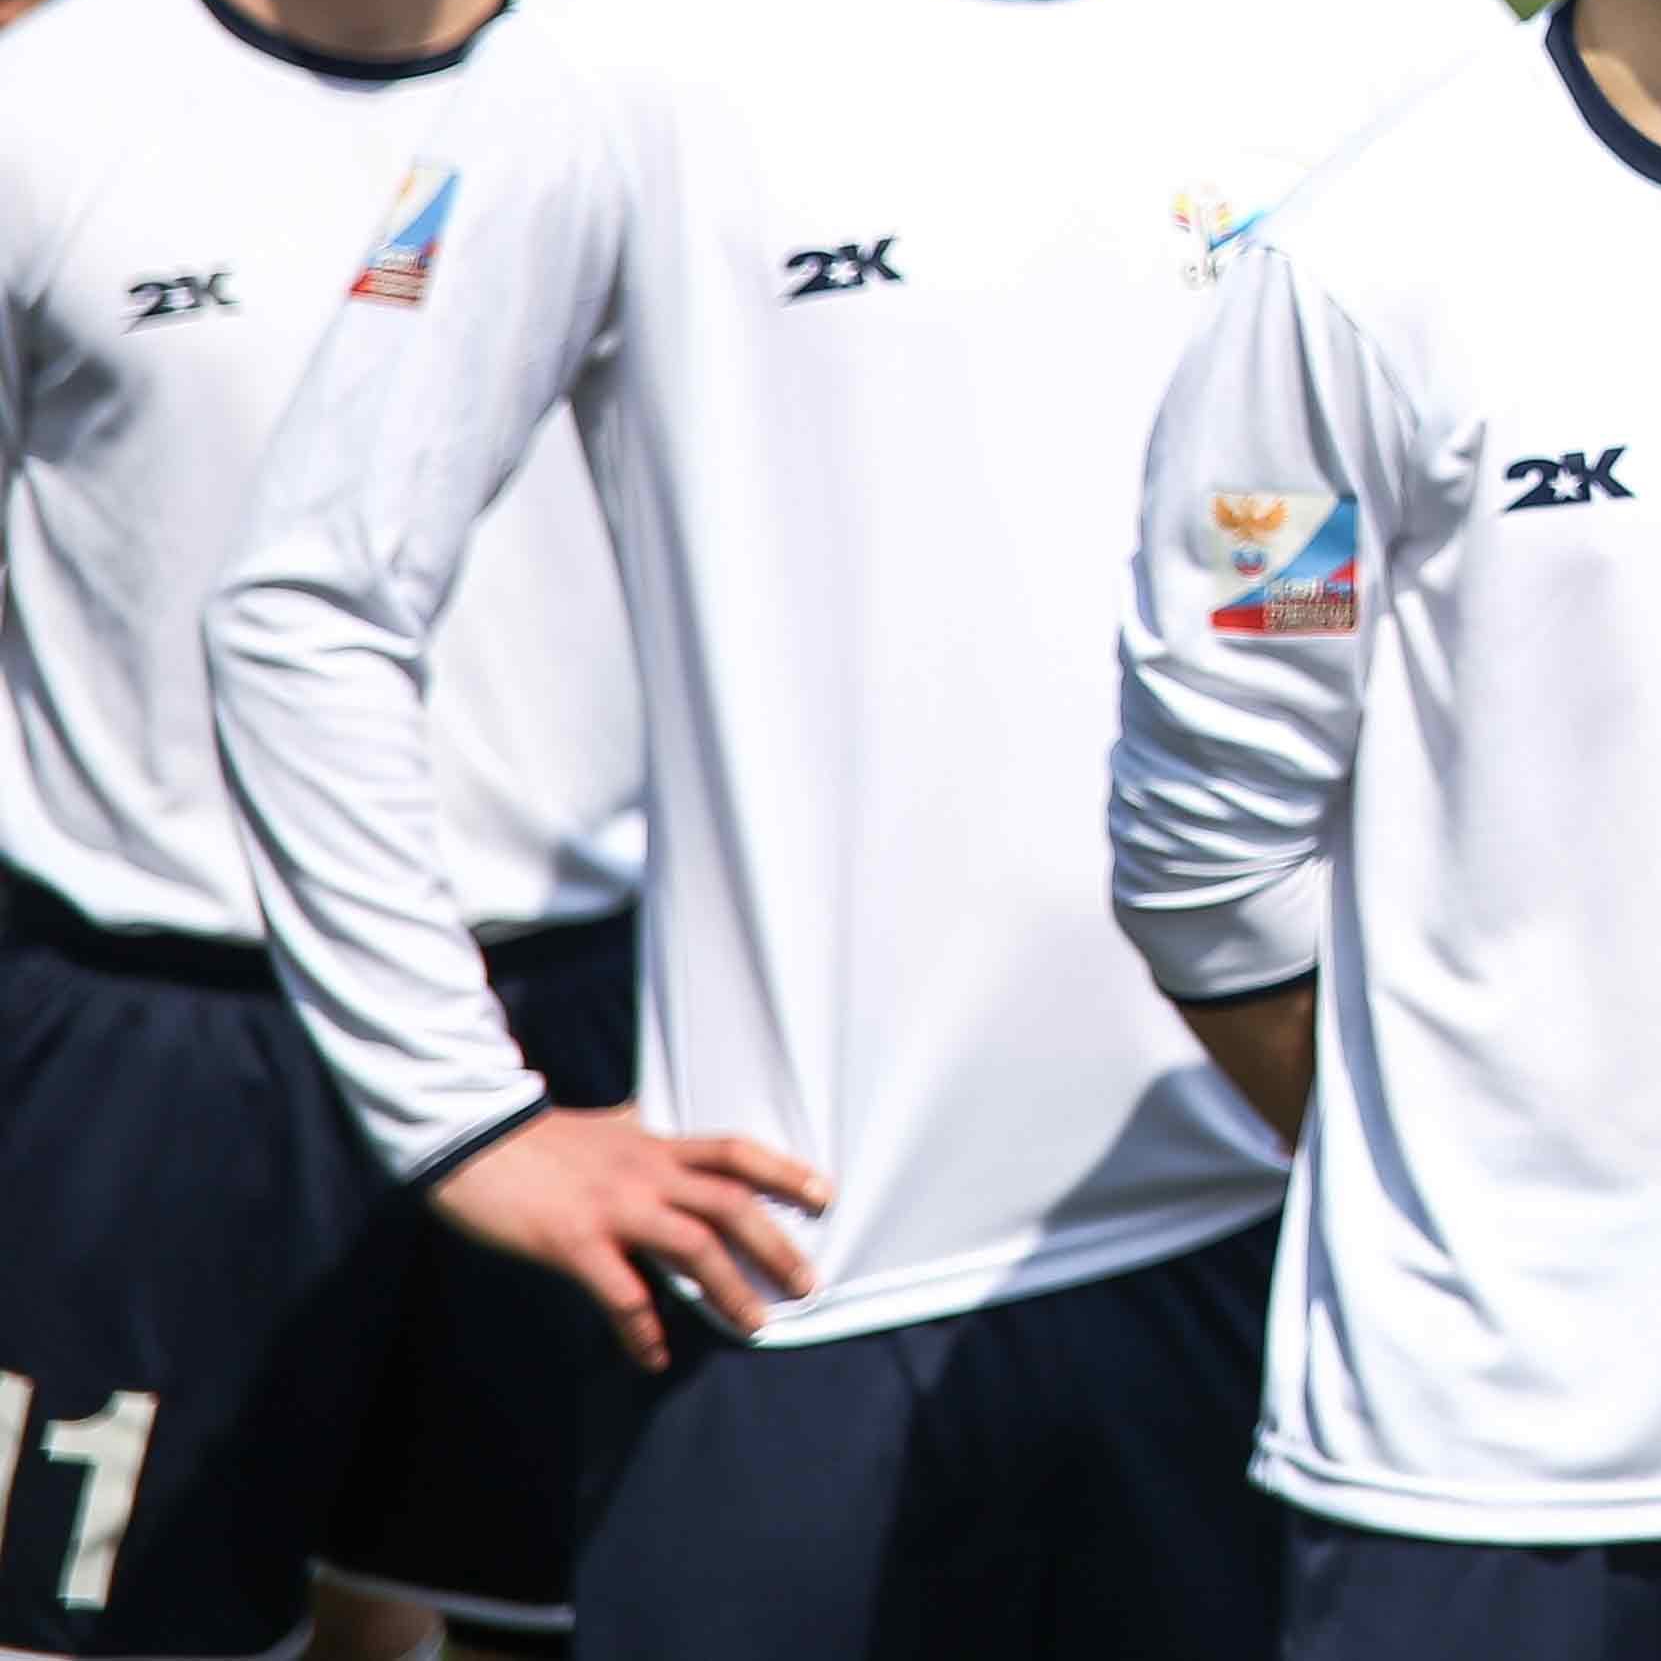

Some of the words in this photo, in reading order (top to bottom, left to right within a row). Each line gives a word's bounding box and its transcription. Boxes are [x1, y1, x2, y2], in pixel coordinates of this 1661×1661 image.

[786, 238, 901, 300] 2K
[125, 273, 235, 333] 2K
[1506, 447, 1632, 512] 2K
